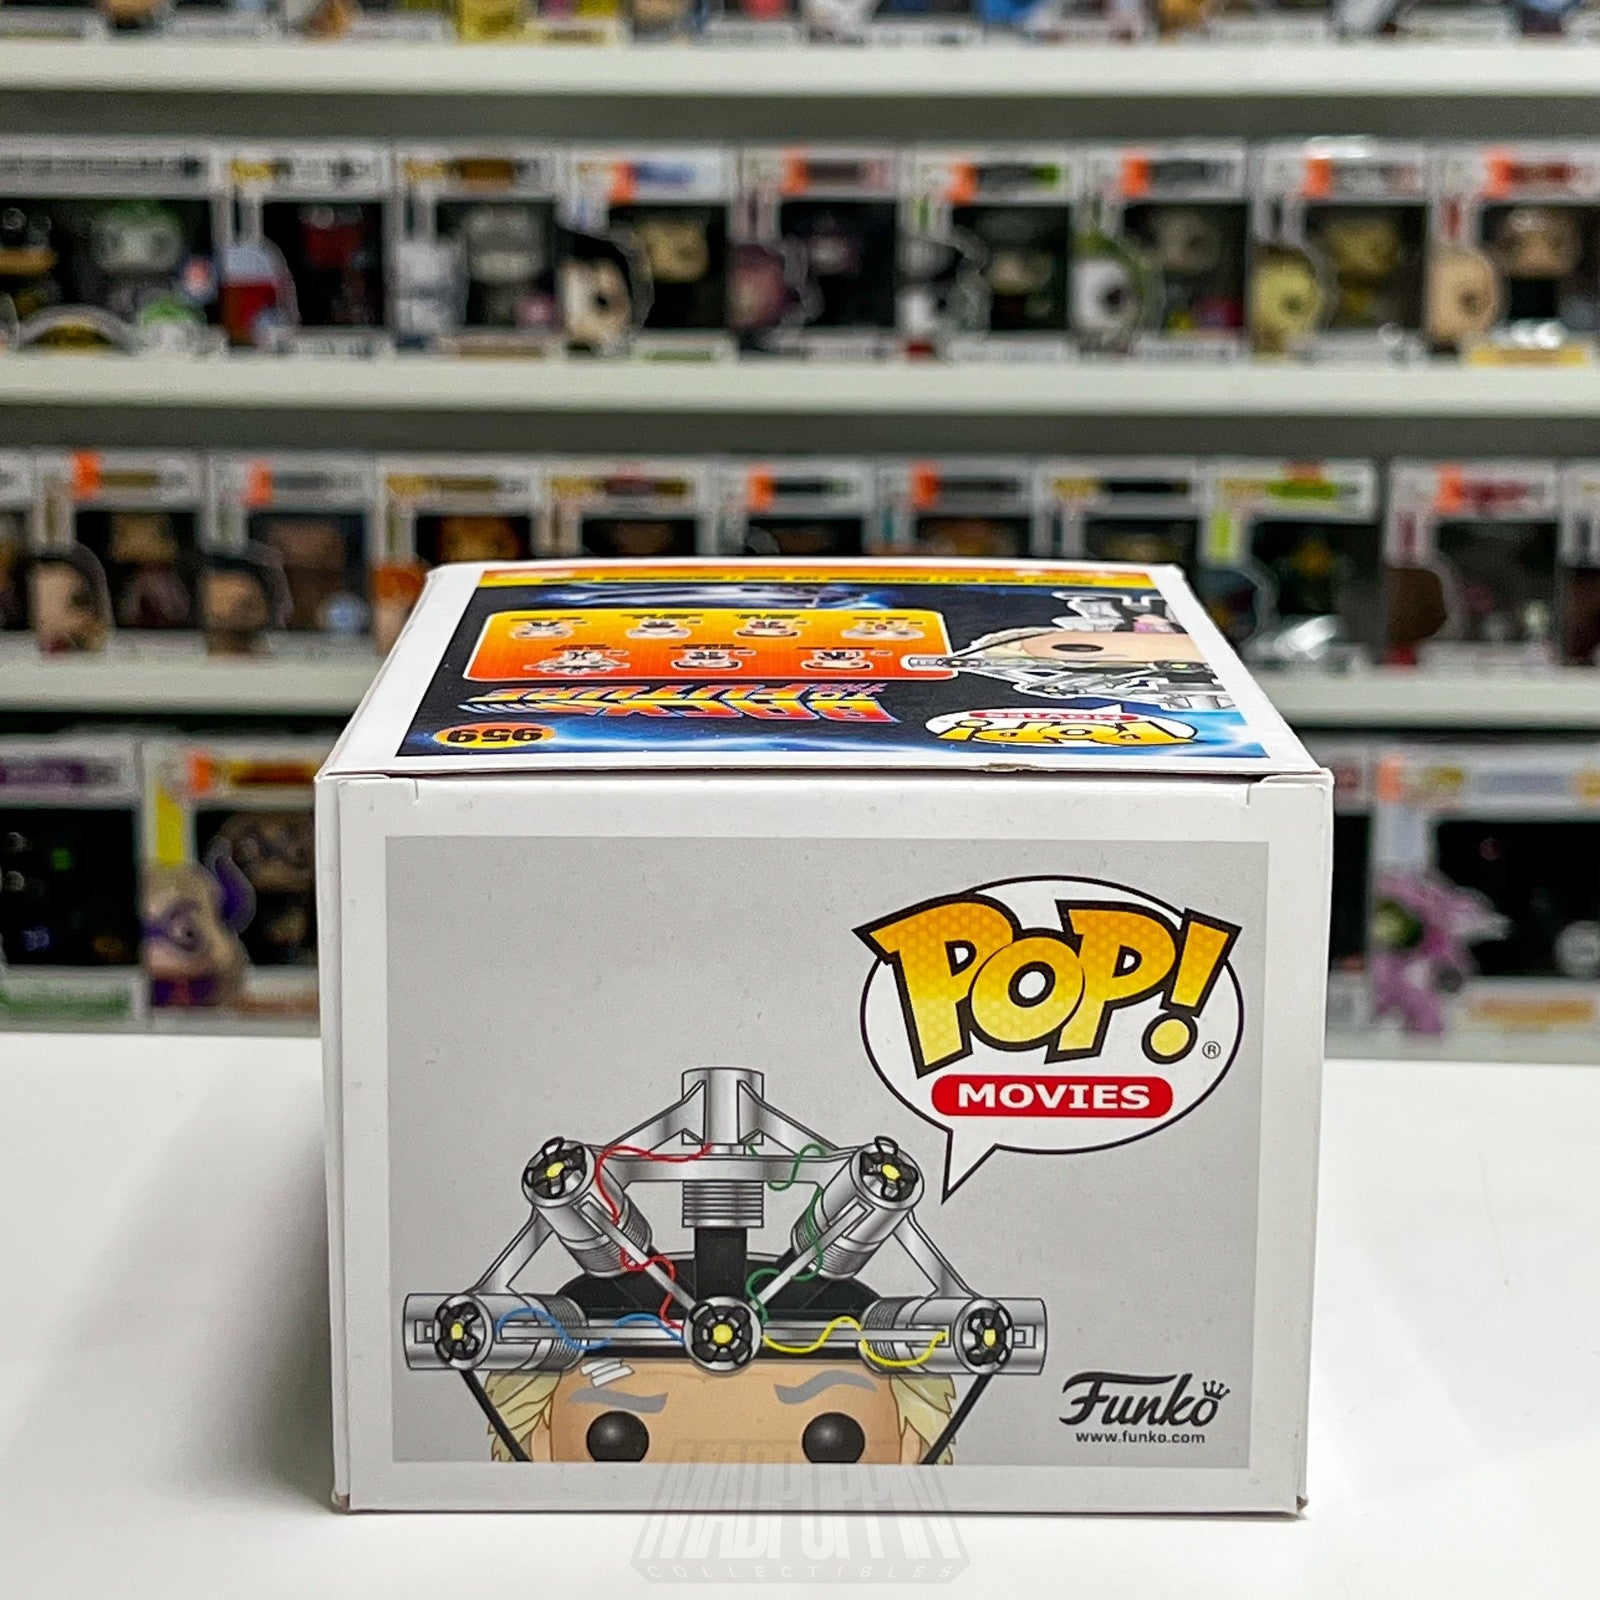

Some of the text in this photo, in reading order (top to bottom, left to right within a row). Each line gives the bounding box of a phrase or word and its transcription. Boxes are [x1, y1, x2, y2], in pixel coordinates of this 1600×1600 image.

[466, 683, 818, 700] FUTURE
[526, 699, 901, 724] BACK
[446, 727, 543, 743] 959
[936, 719, 1195, 745] POP!
[852, 892, 1242, 1078] POP!
[957, 1083, 1150, 1110] MOVIES
[1058, 1371, 1219, 1427] Funko
[1075, 1430, 1206, 1444] www.funko.com
